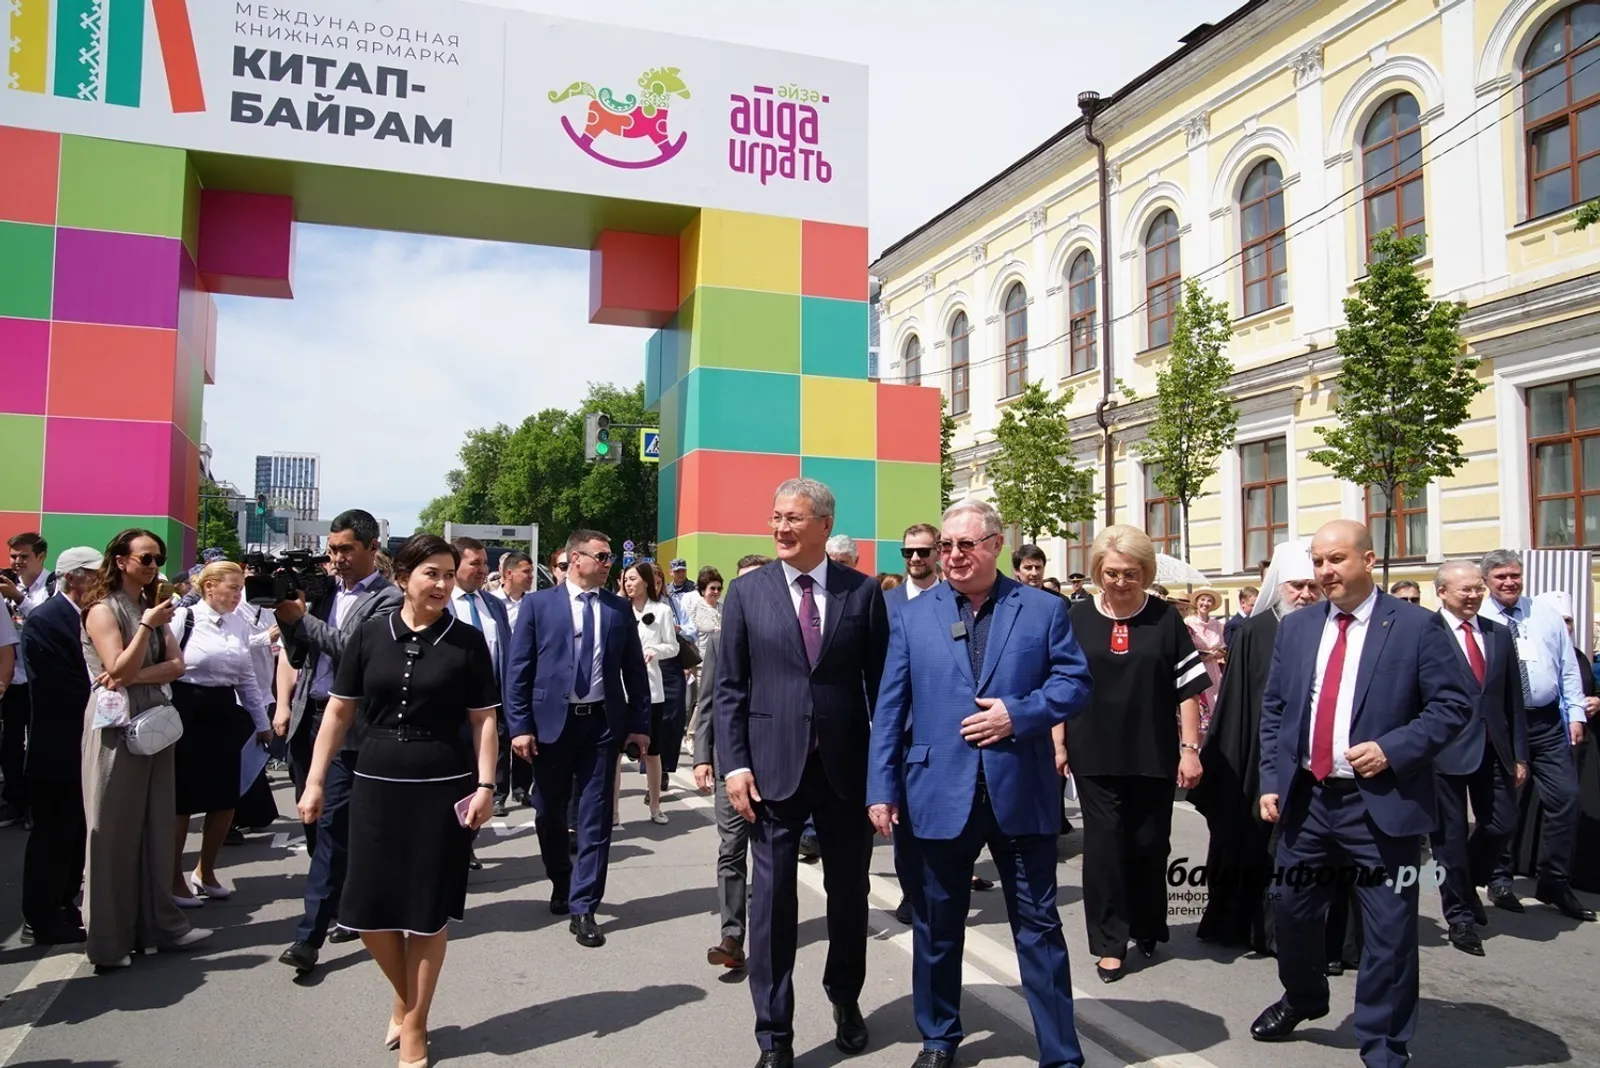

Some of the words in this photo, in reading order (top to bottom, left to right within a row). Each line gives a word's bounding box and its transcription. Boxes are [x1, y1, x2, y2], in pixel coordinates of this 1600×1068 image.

[235, 1, 460, 48] МЕЖДУНАРОДНАЯ
[235, 21, 349, 50] КНИЖНАЯ
[356, 39, 460, 66] ЯРМАРКА
[232, 45, 426, 99] КИТАП-
[230, 90, 453, 148] БАЙРАМ
[729, 138, 832, 186] играть
